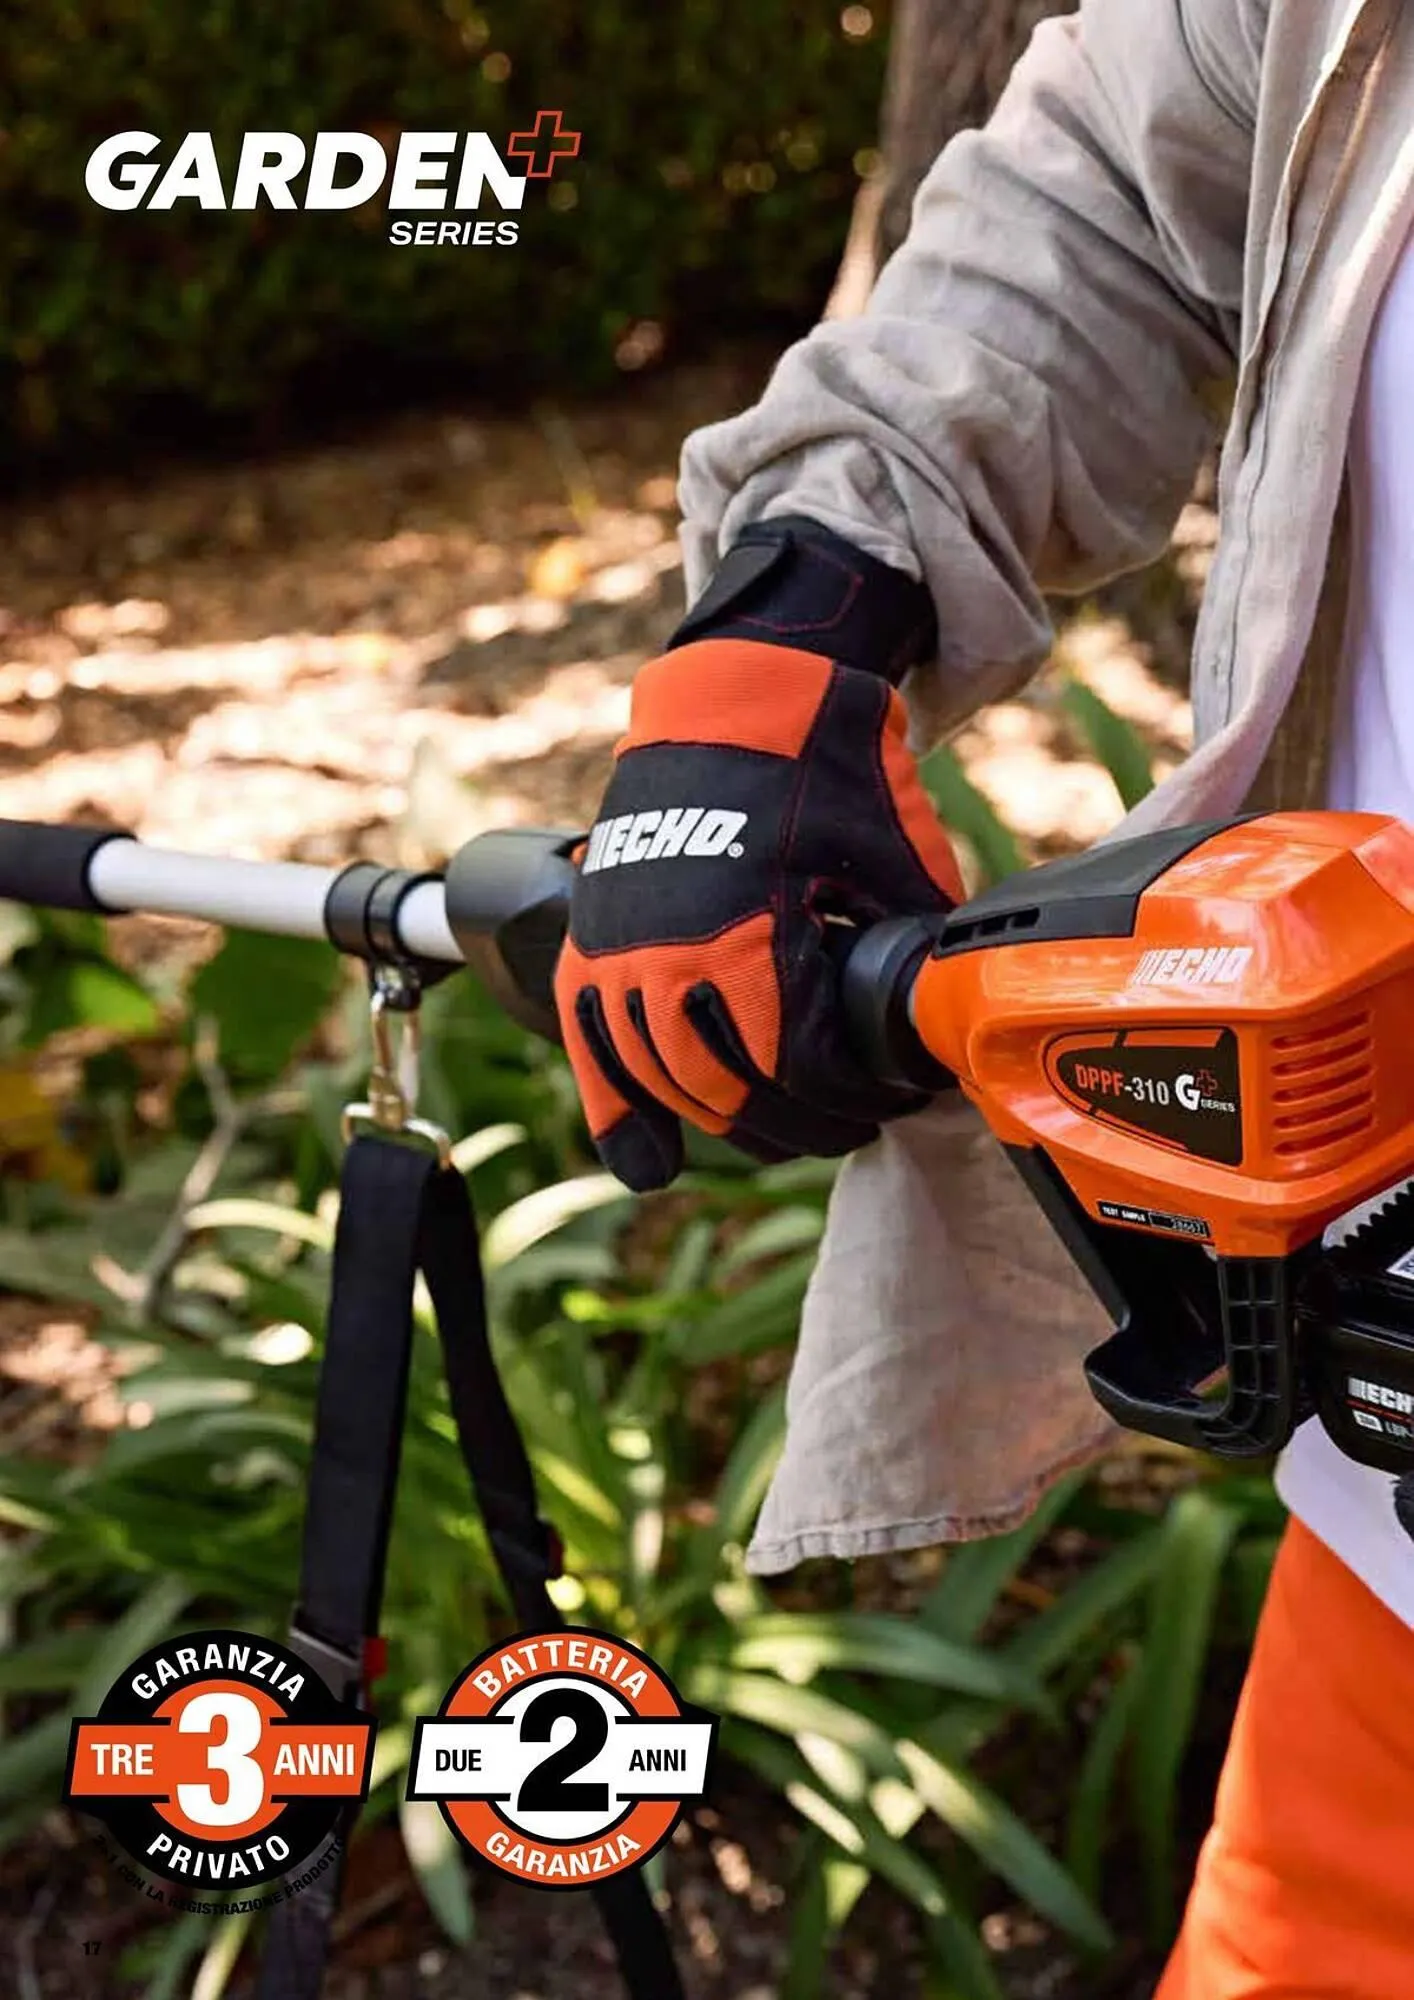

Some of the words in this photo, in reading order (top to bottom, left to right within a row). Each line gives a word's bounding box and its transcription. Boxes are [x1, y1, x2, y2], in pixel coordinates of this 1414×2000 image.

[600, 807, 748, 867] ECHO
[1146, 947, 1254, 984] ECHO
[1363, 1381, 1414, 1414] ECH
